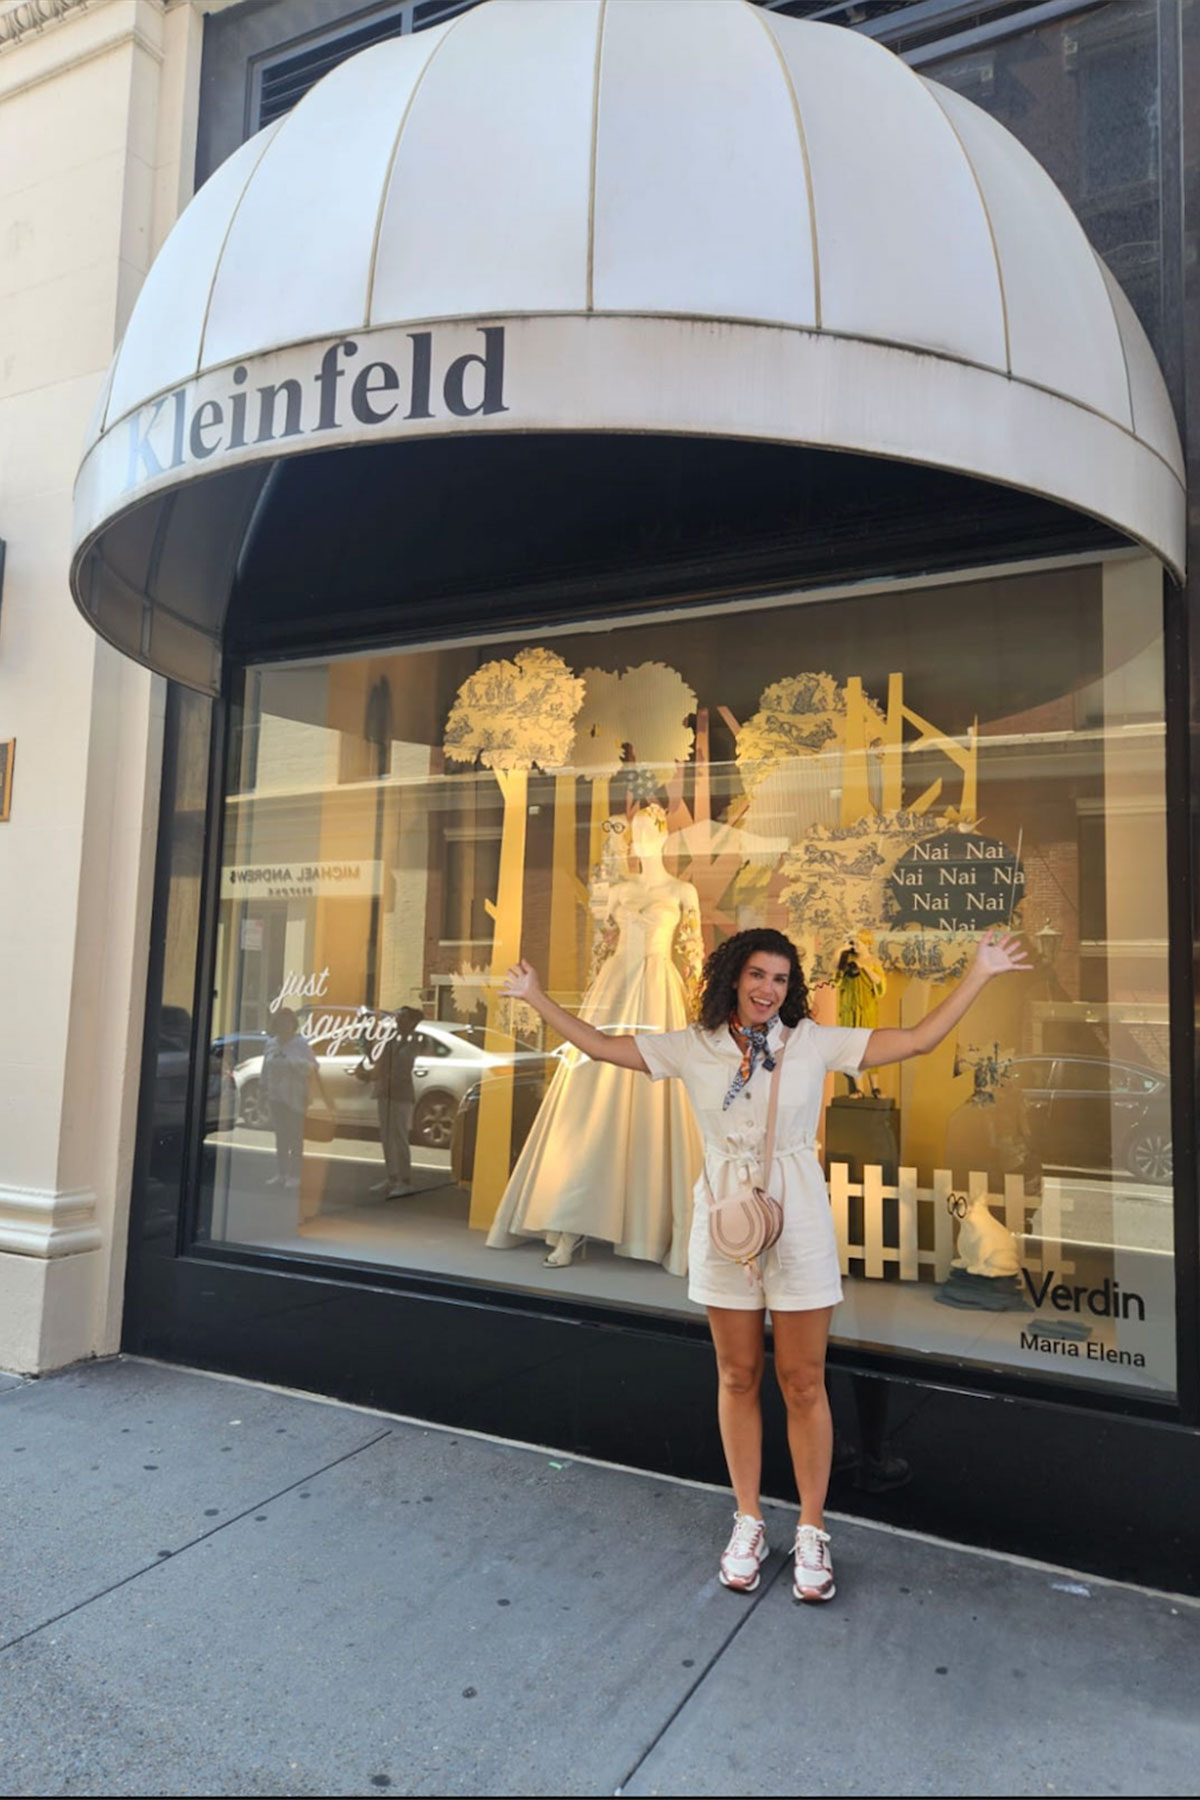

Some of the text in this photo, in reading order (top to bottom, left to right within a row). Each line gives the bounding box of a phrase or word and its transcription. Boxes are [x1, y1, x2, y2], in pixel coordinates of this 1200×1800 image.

[122, 326, 509, 494] Kleinfeld
[912, 841, 1004, 861] Nai Nai
[939, 867, 977, 886] Nai
[992, 866, 1025, 885] Na
[912, 892, 1004, 911] Nai Nai
[269, 967, 330, 1013] just
[300, 1005, 424, 1060] saying...
[1021, 1267, 1145, 1321] Verdin
[1020, 1332, 1146, 1368] Maria Elena
